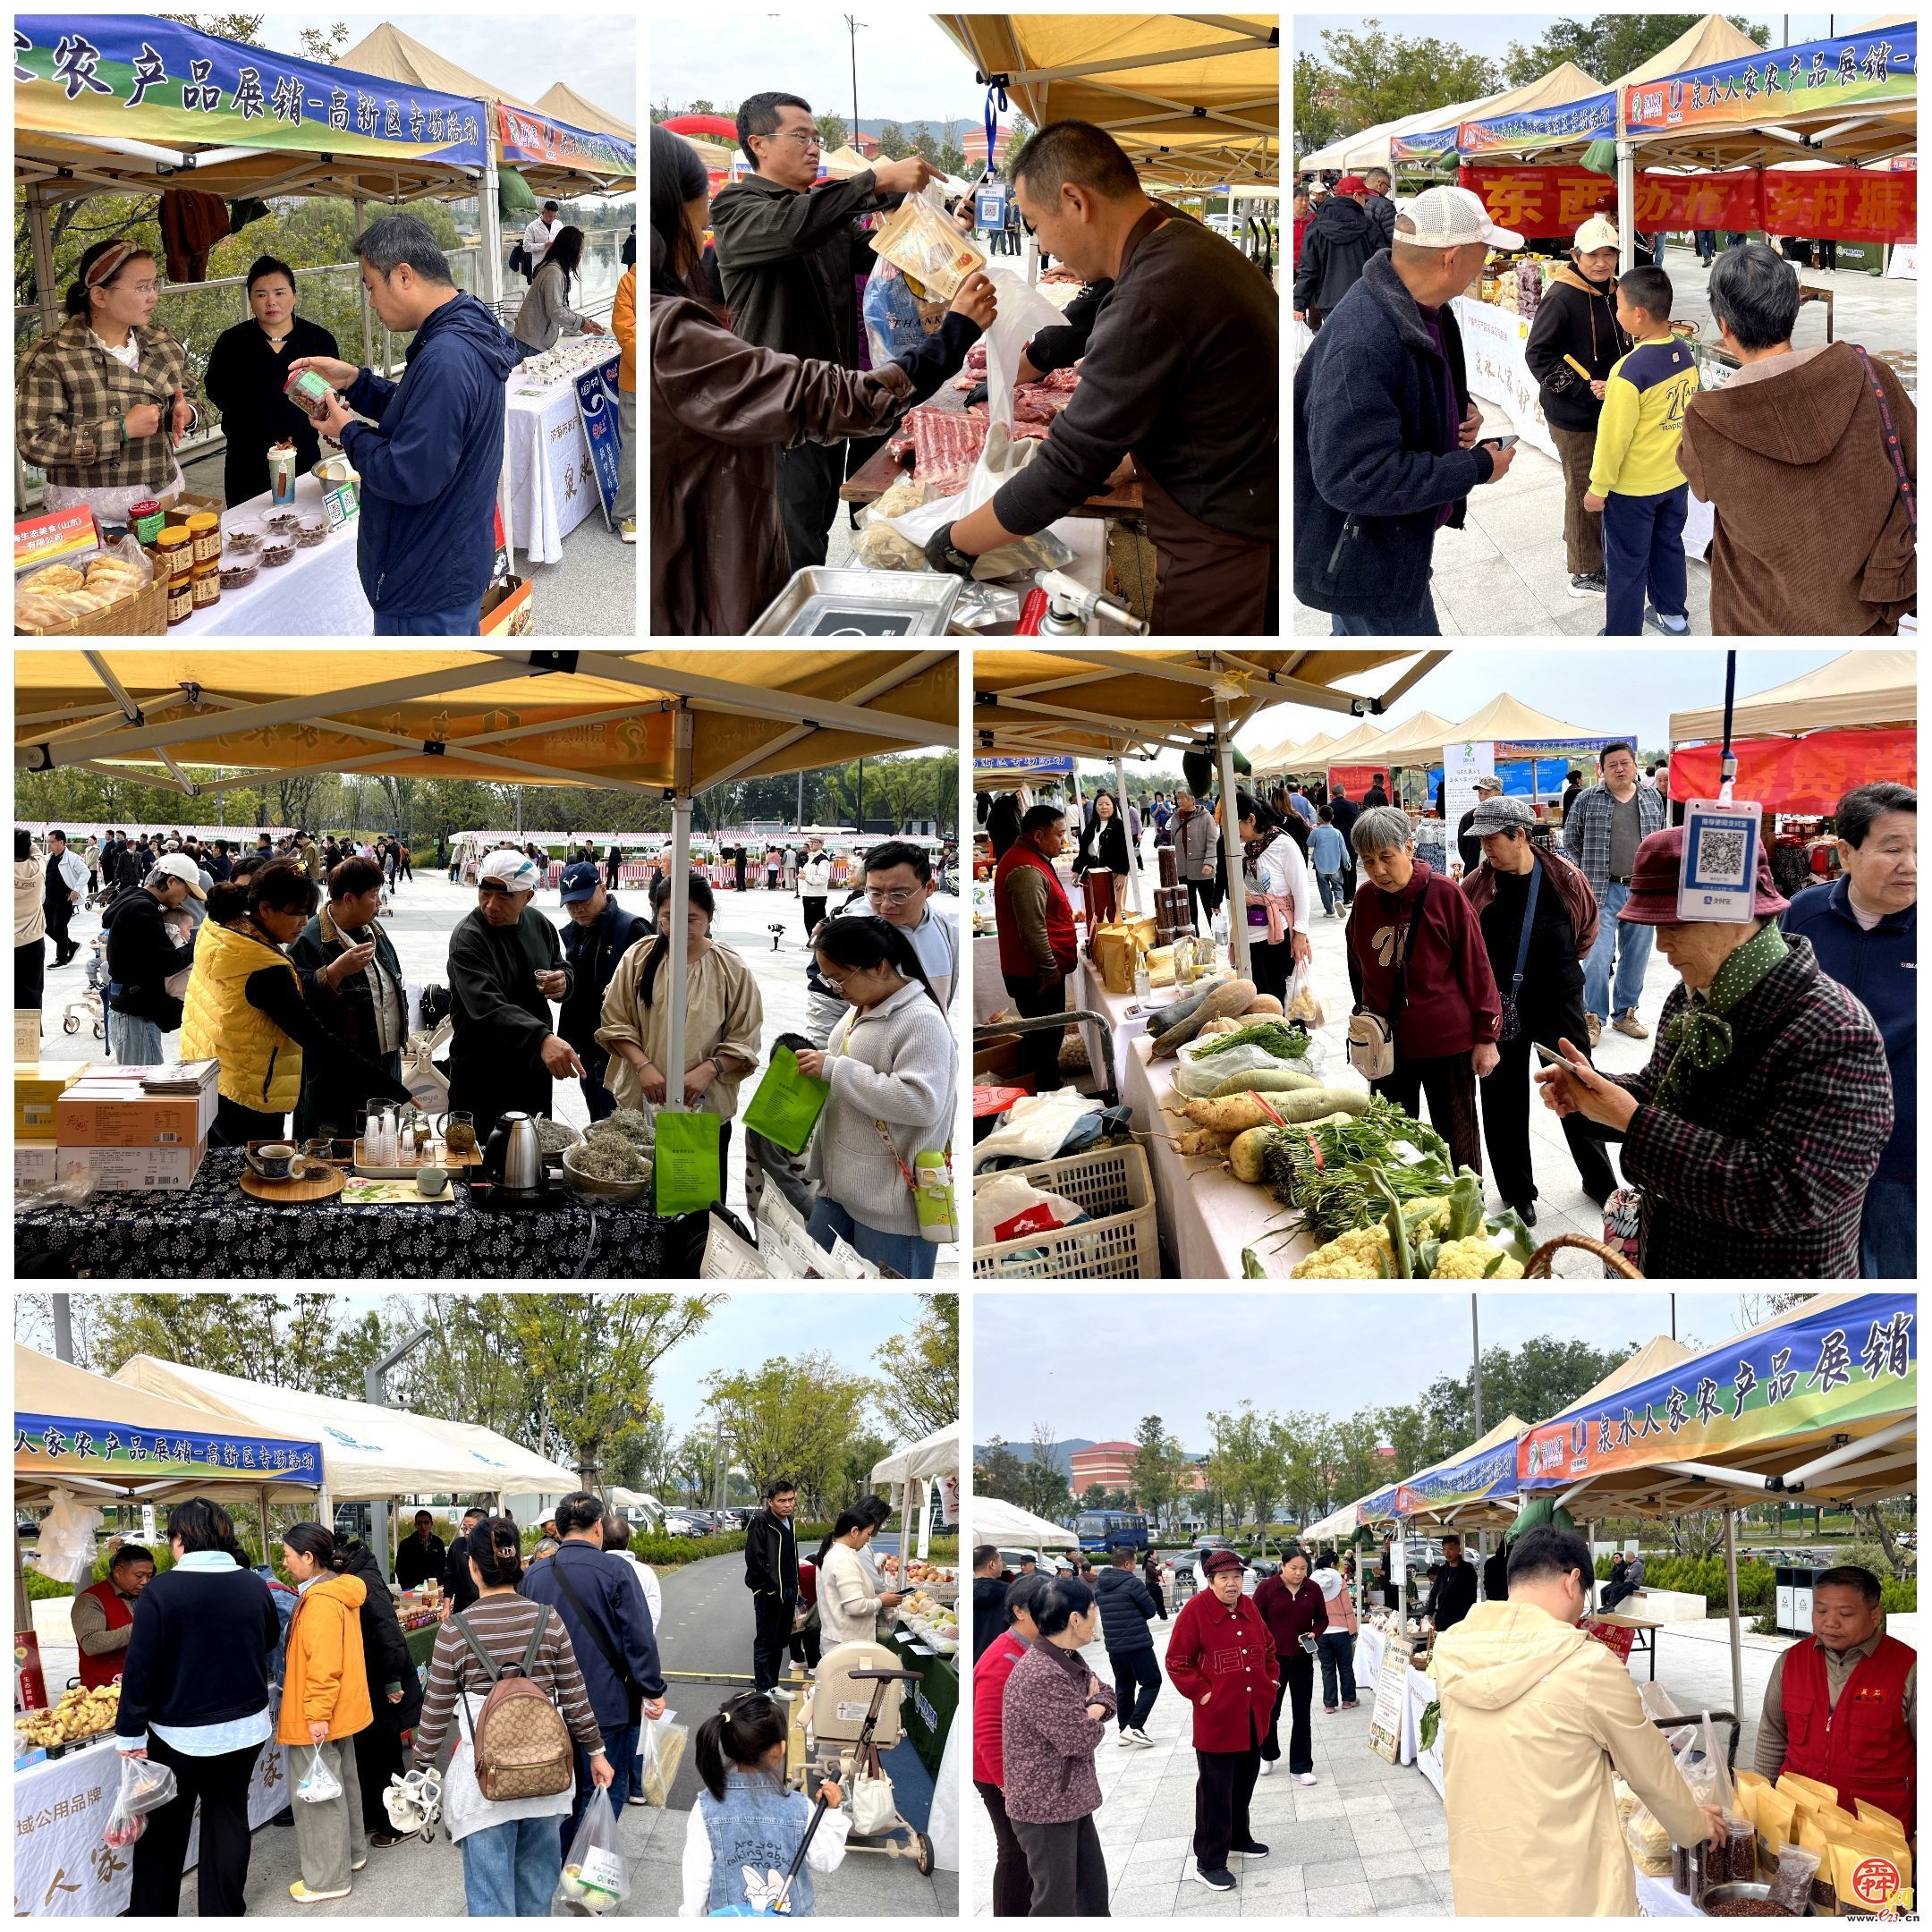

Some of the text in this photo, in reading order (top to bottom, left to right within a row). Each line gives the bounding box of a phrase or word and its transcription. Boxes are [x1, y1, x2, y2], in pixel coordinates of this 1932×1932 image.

[1690, 41, 1917, 111] 泉水人家农产品展销-
[1765, 179, 1917, 230] 乡村振
[1662, 422, 1682, 431] mapg
[27, 534, 64, 550] 有限公司
[1597, 1311, 1914, 1453] 泉水人家农产品展销
[14, 1428, 315, 1470] 人家农产品展销-高新区专场活动
